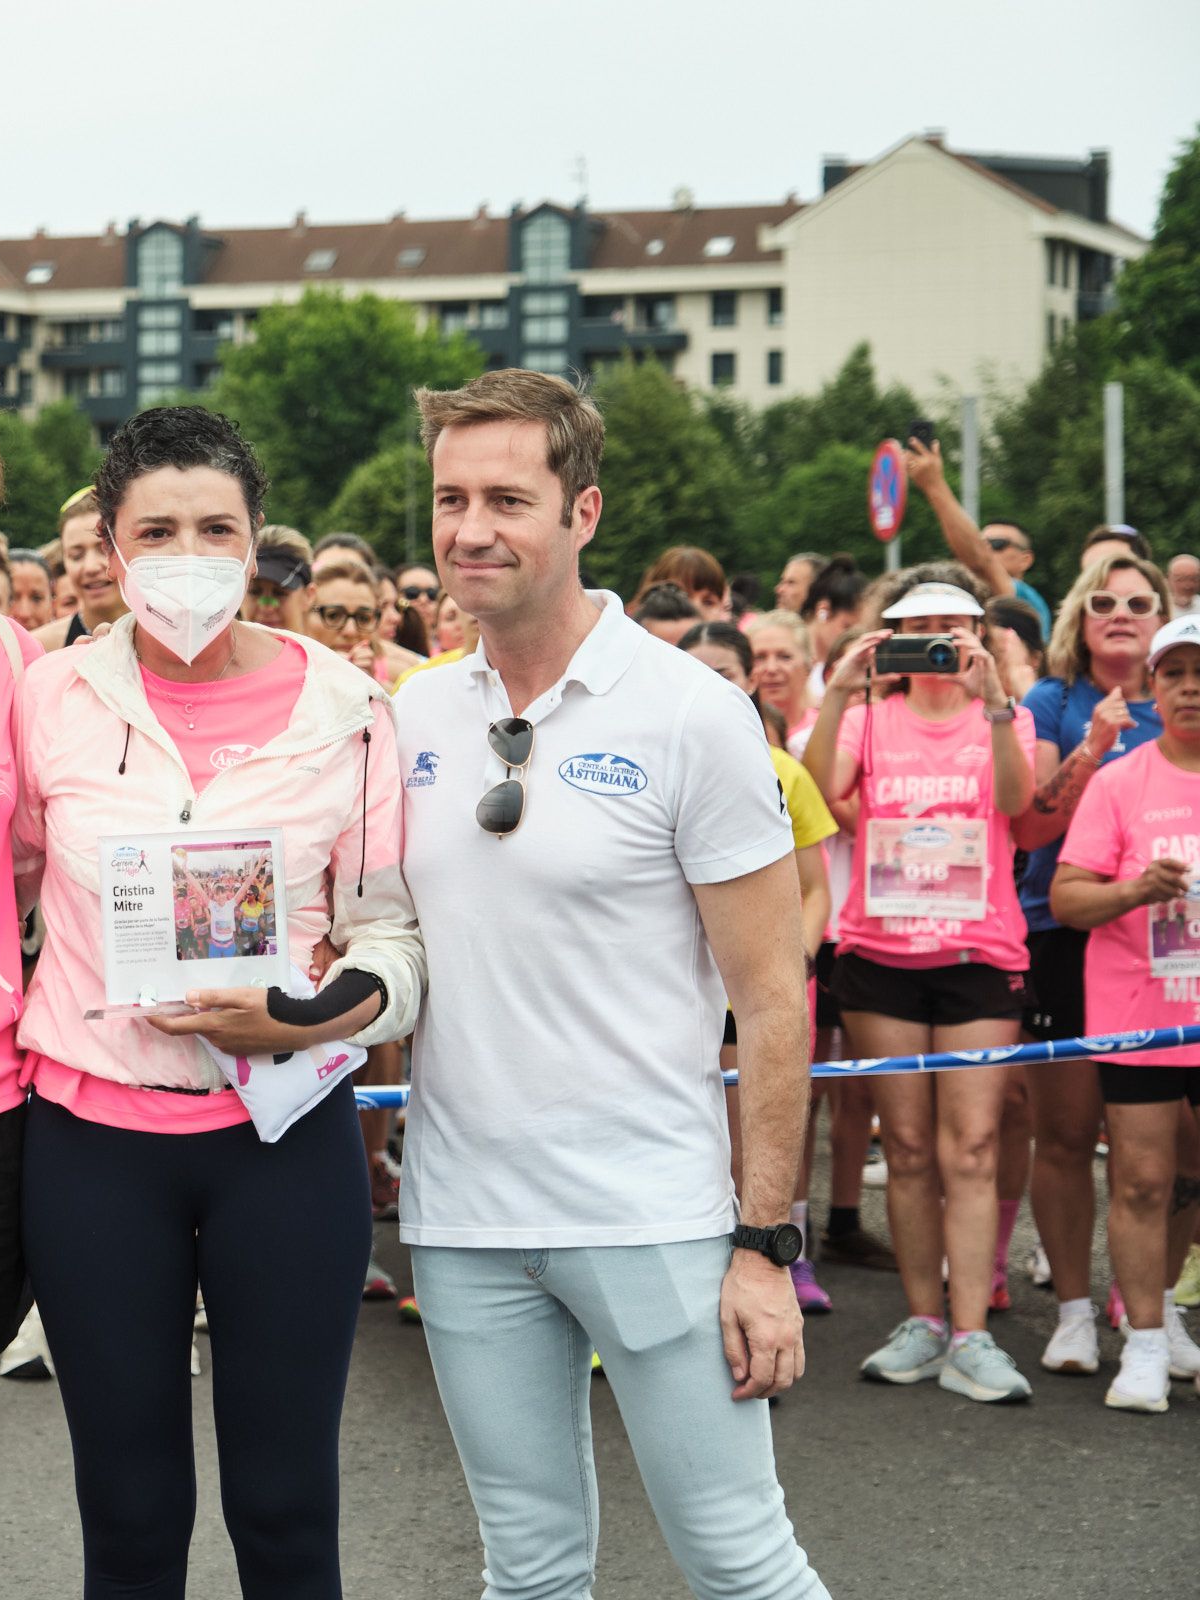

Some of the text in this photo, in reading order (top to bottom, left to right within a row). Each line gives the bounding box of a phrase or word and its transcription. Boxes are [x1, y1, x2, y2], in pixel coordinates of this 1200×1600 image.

[578, 761, 608, 772] CENTRAL
[563, 761, 640, 790] ASTURIANA
[904, 863, 950, 881] 016
[113, 884, 155, 897] Cristina
[114, 900, 143, 912] Mitre
